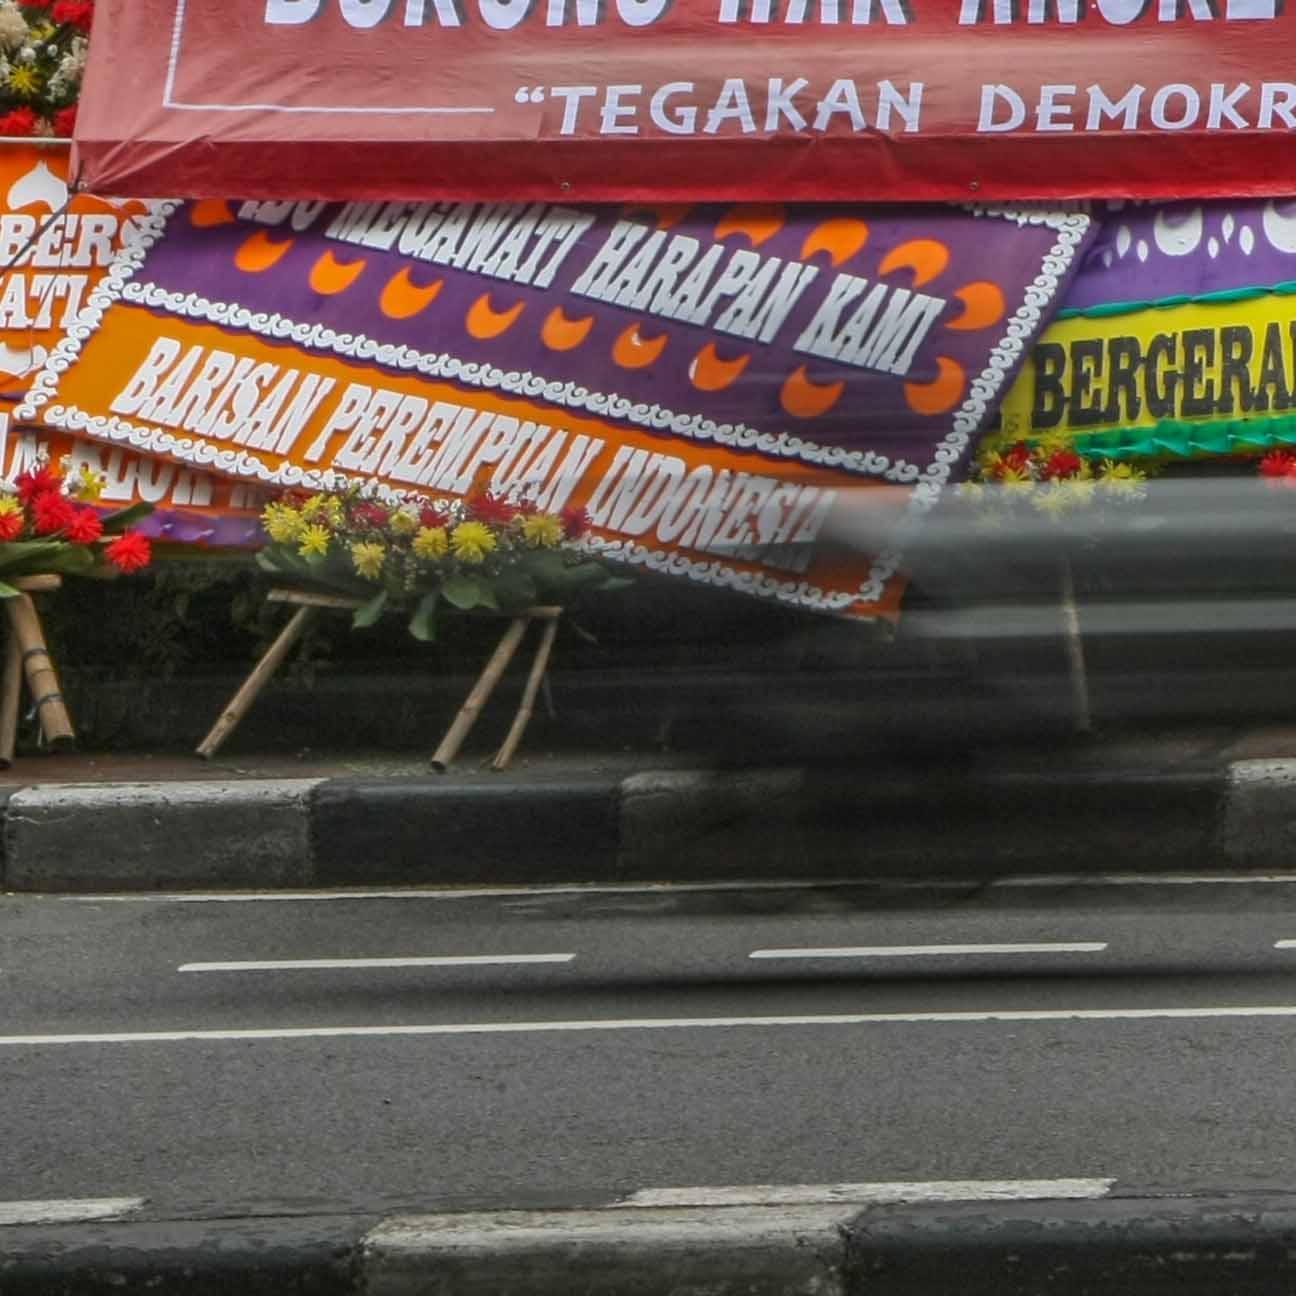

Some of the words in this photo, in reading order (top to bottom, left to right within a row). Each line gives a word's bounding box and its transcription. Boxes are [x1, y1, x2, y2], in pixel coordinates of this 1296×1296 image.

[514, 77, 923, 135] “TEGAKAN
[0, 274, 88, 329] ATI
[570, 219, 819, 345] HARAPAN
[793, 273, 947, 376] KAMI
[110, 336, 337, 456] BARISAN
[304, 383, 605, 514] PEREMPUAN
[586, 442, 838, 571] INDONESIA
